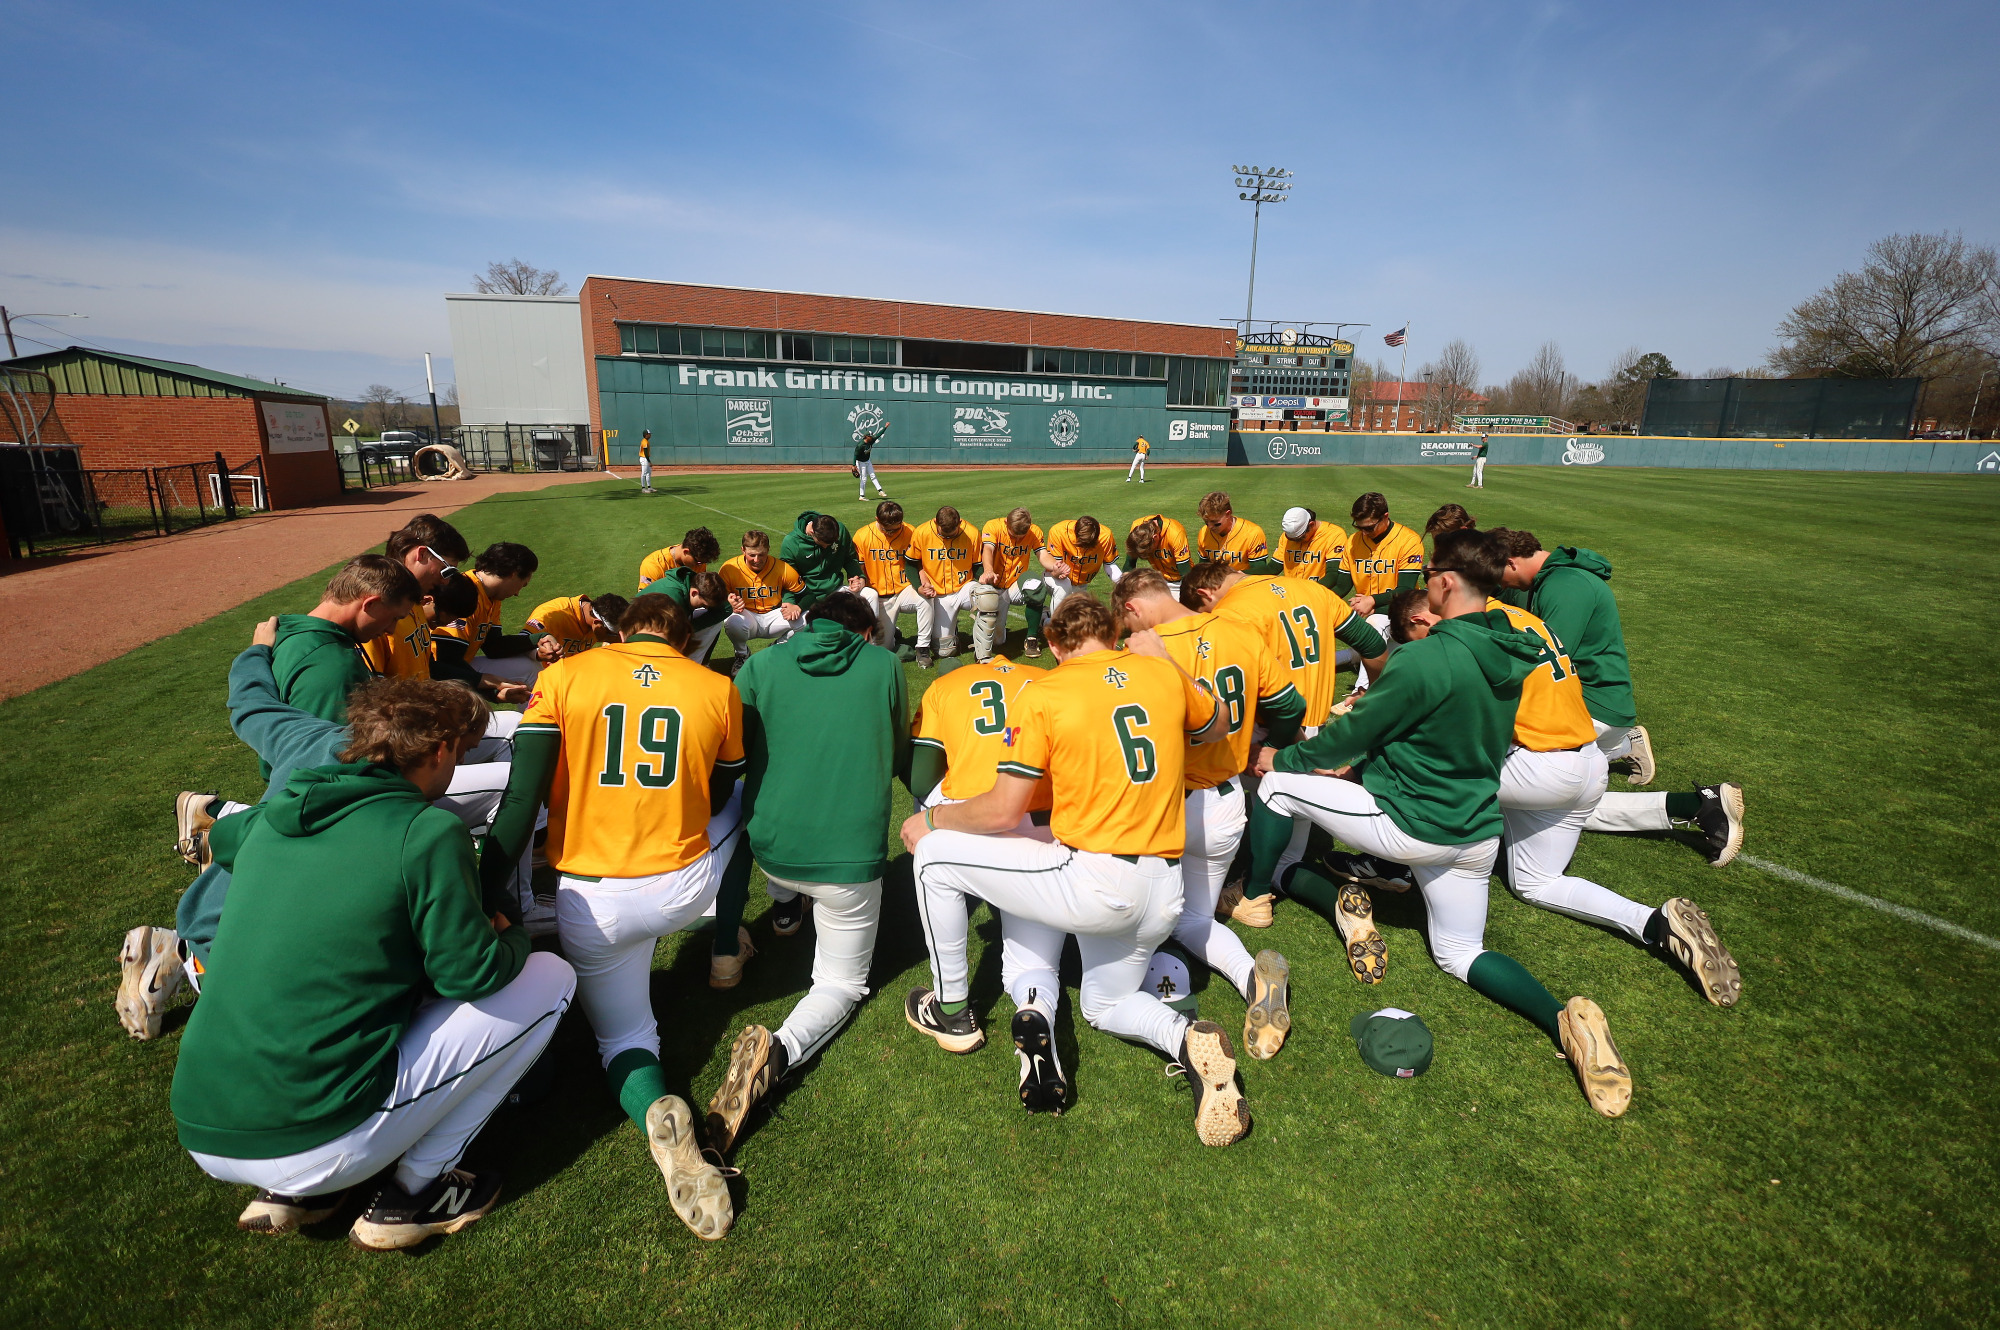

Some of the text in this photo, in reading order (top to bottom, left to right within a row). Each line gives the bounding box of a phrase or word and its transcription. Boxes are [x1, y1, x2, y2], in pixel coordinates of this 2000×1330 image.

[1245, 345, 1331, 355] ARKANSAS TECH UNIVERSITY
[1333, 343, 1351, 353] TECH
[1276, 357, 1297, 365] STRIKE
[678, 364, 1113, 401] Frank Griffin Oil Company, Inc.
[728, 400, 769, 412] DARRELLS'
[1277, 399, 1300, 407] pepsi
[847, 403, 883, 423] BLUE
[954, 408, 984, 420] PDQ
[854, 418, 883, 432] ice
[1049, 413, 1058, 427] FAT
[1467, 417, 1500, 425] WELCOME
[736, 429, 764, 437] Other
[1189, 423, 1225, 431] Simmons
[1050, 434, 1079, 447] BAR-B-QUE
[1189, 431, 1209, 439] Bank
[1289, 443, 1321, 456] Tyson
[928, 548, 967, 561] TECH
[1063, 550, 1098, 566] TECH
[1154, 549, 1172, 559] CH
[1205, 549, 1242, 563] TECH
[1286, 550, 1321, 564] TECH
[1354, 559, 1396, 574] TECH
[735, 586, 779, 599] TECH
[403, 622, 431, 659] TEC
[1278, 604, 1321, 671] 13
[561, 638, 594, 654] TECH
[598, 702, 683, 789] 19
[1111, 703, 1158, 784] 6
